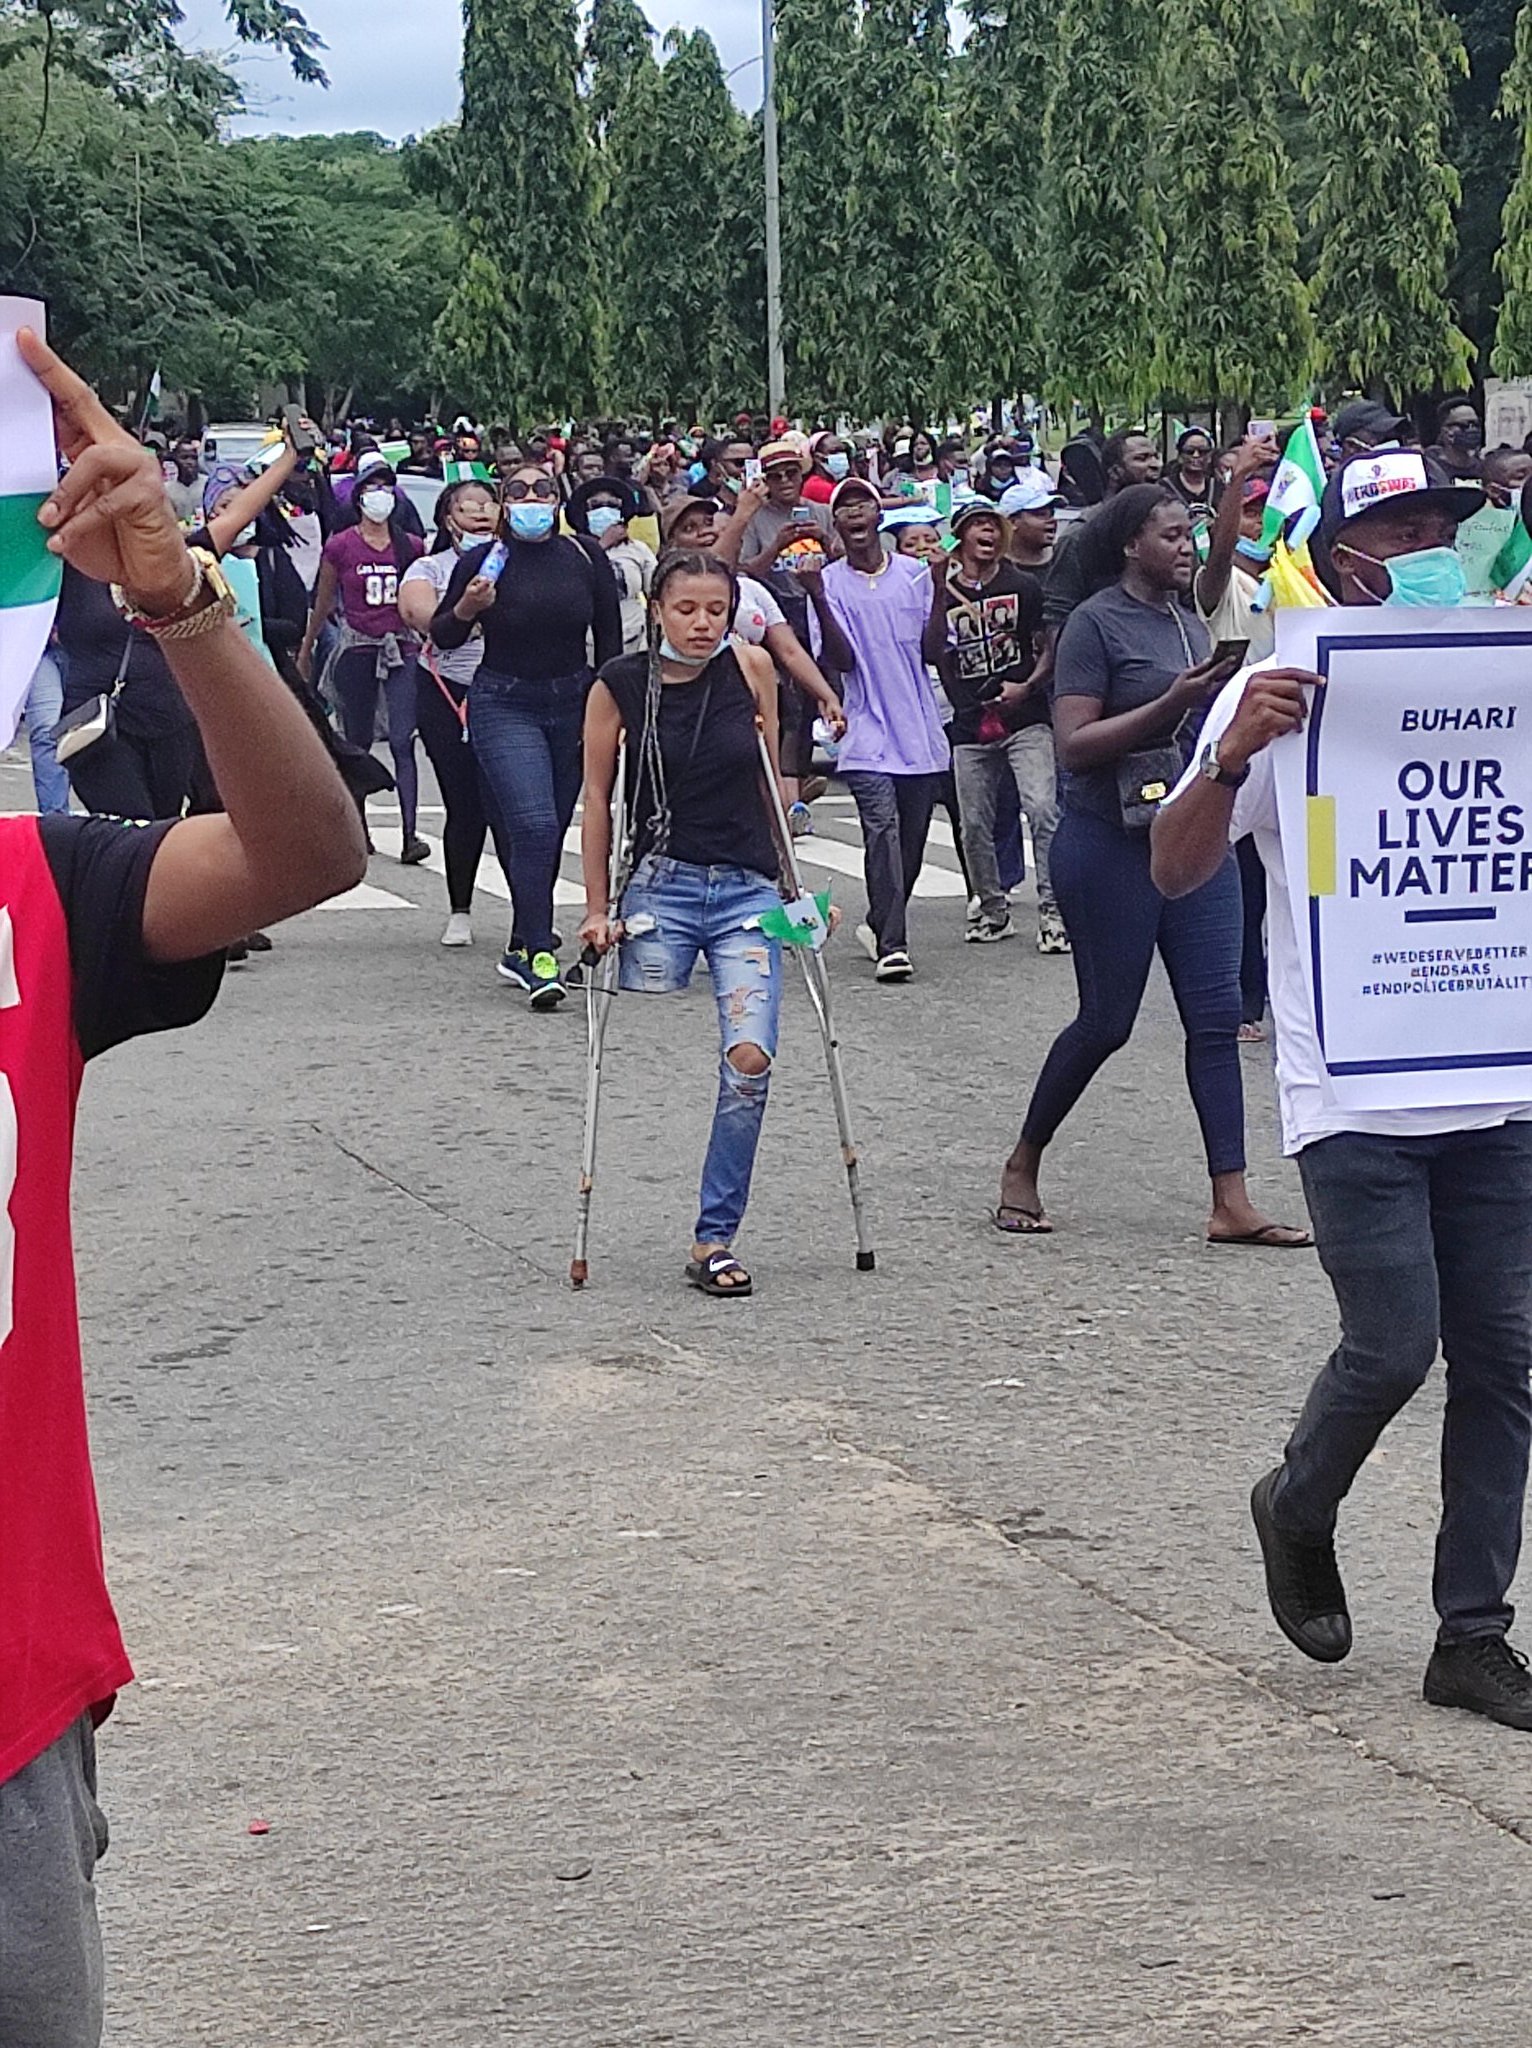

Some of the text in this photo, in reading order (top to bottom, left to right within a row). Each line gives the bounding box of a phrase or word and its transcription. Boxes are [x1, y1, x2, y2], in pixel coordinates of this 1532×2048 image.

[1401, 706, 1517, 732] BUHARI
[1398, 759, 1505, 801] OUR
[1378, 805, 1524, 849] LIVES
[1372, 946, 1527, 964] #WEDESERVEBETTER
[1410, 963, 1491, 978] #ENDSARS
[1362, 976, 1532, 996] #ENDPOLICEBRUTALIT
